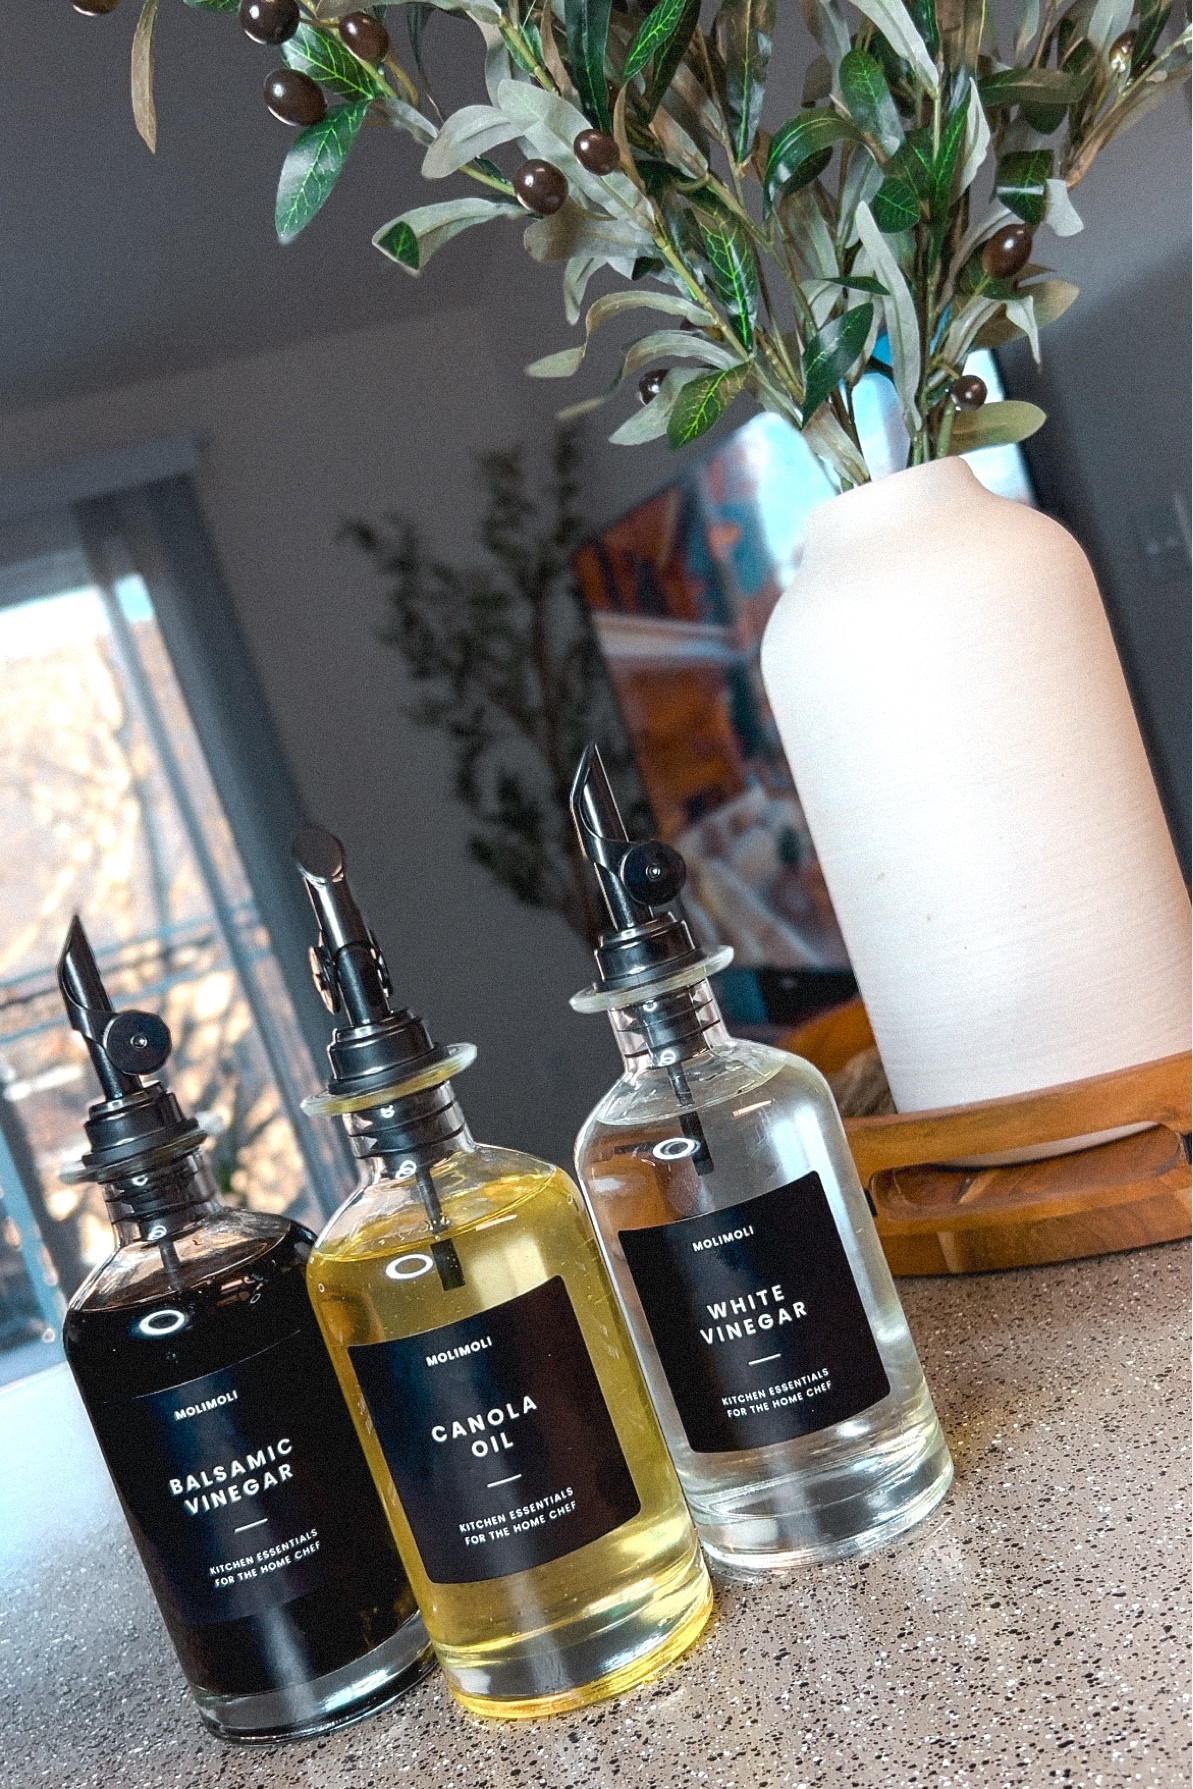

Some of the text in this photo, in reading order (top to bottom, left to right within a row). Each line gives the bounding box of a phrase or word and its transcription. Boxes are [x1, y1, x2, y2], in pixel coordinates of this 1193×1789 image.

[692, 1225, 754, 1252] MOLIMOLI
[699, 1301, 808, 1345] VINEGAR
[706, 1284, 785, 1320] WHITE
[425, 1335, 493, 1367] MOLIMOLI
[173, 1389, 238, 1421] MOLIMOLI
[720, 1367, 829, 1407] KITCHEN ESSENTIALS
[725, 1380, 831, 1419] FOR THE HOME CHEF
[431, 1395, 538, 1443] CANOLA
[169, 1438, 293, 1495] BALSAMIC
[471, 1431, 514, 1458] OIL
[184, 1463, 293, 1515] VINEGAR
[457, 1486, 574, 1534] KITCHEN ESSENTIALS
[463, 1500, 576, 1547] FOR THE HOME CHEF
[208, 1528, 318, 1576] KITCHEN ESSENTIALS
[213, 1540, 320, 1588] FOR THE HOME CHEF
